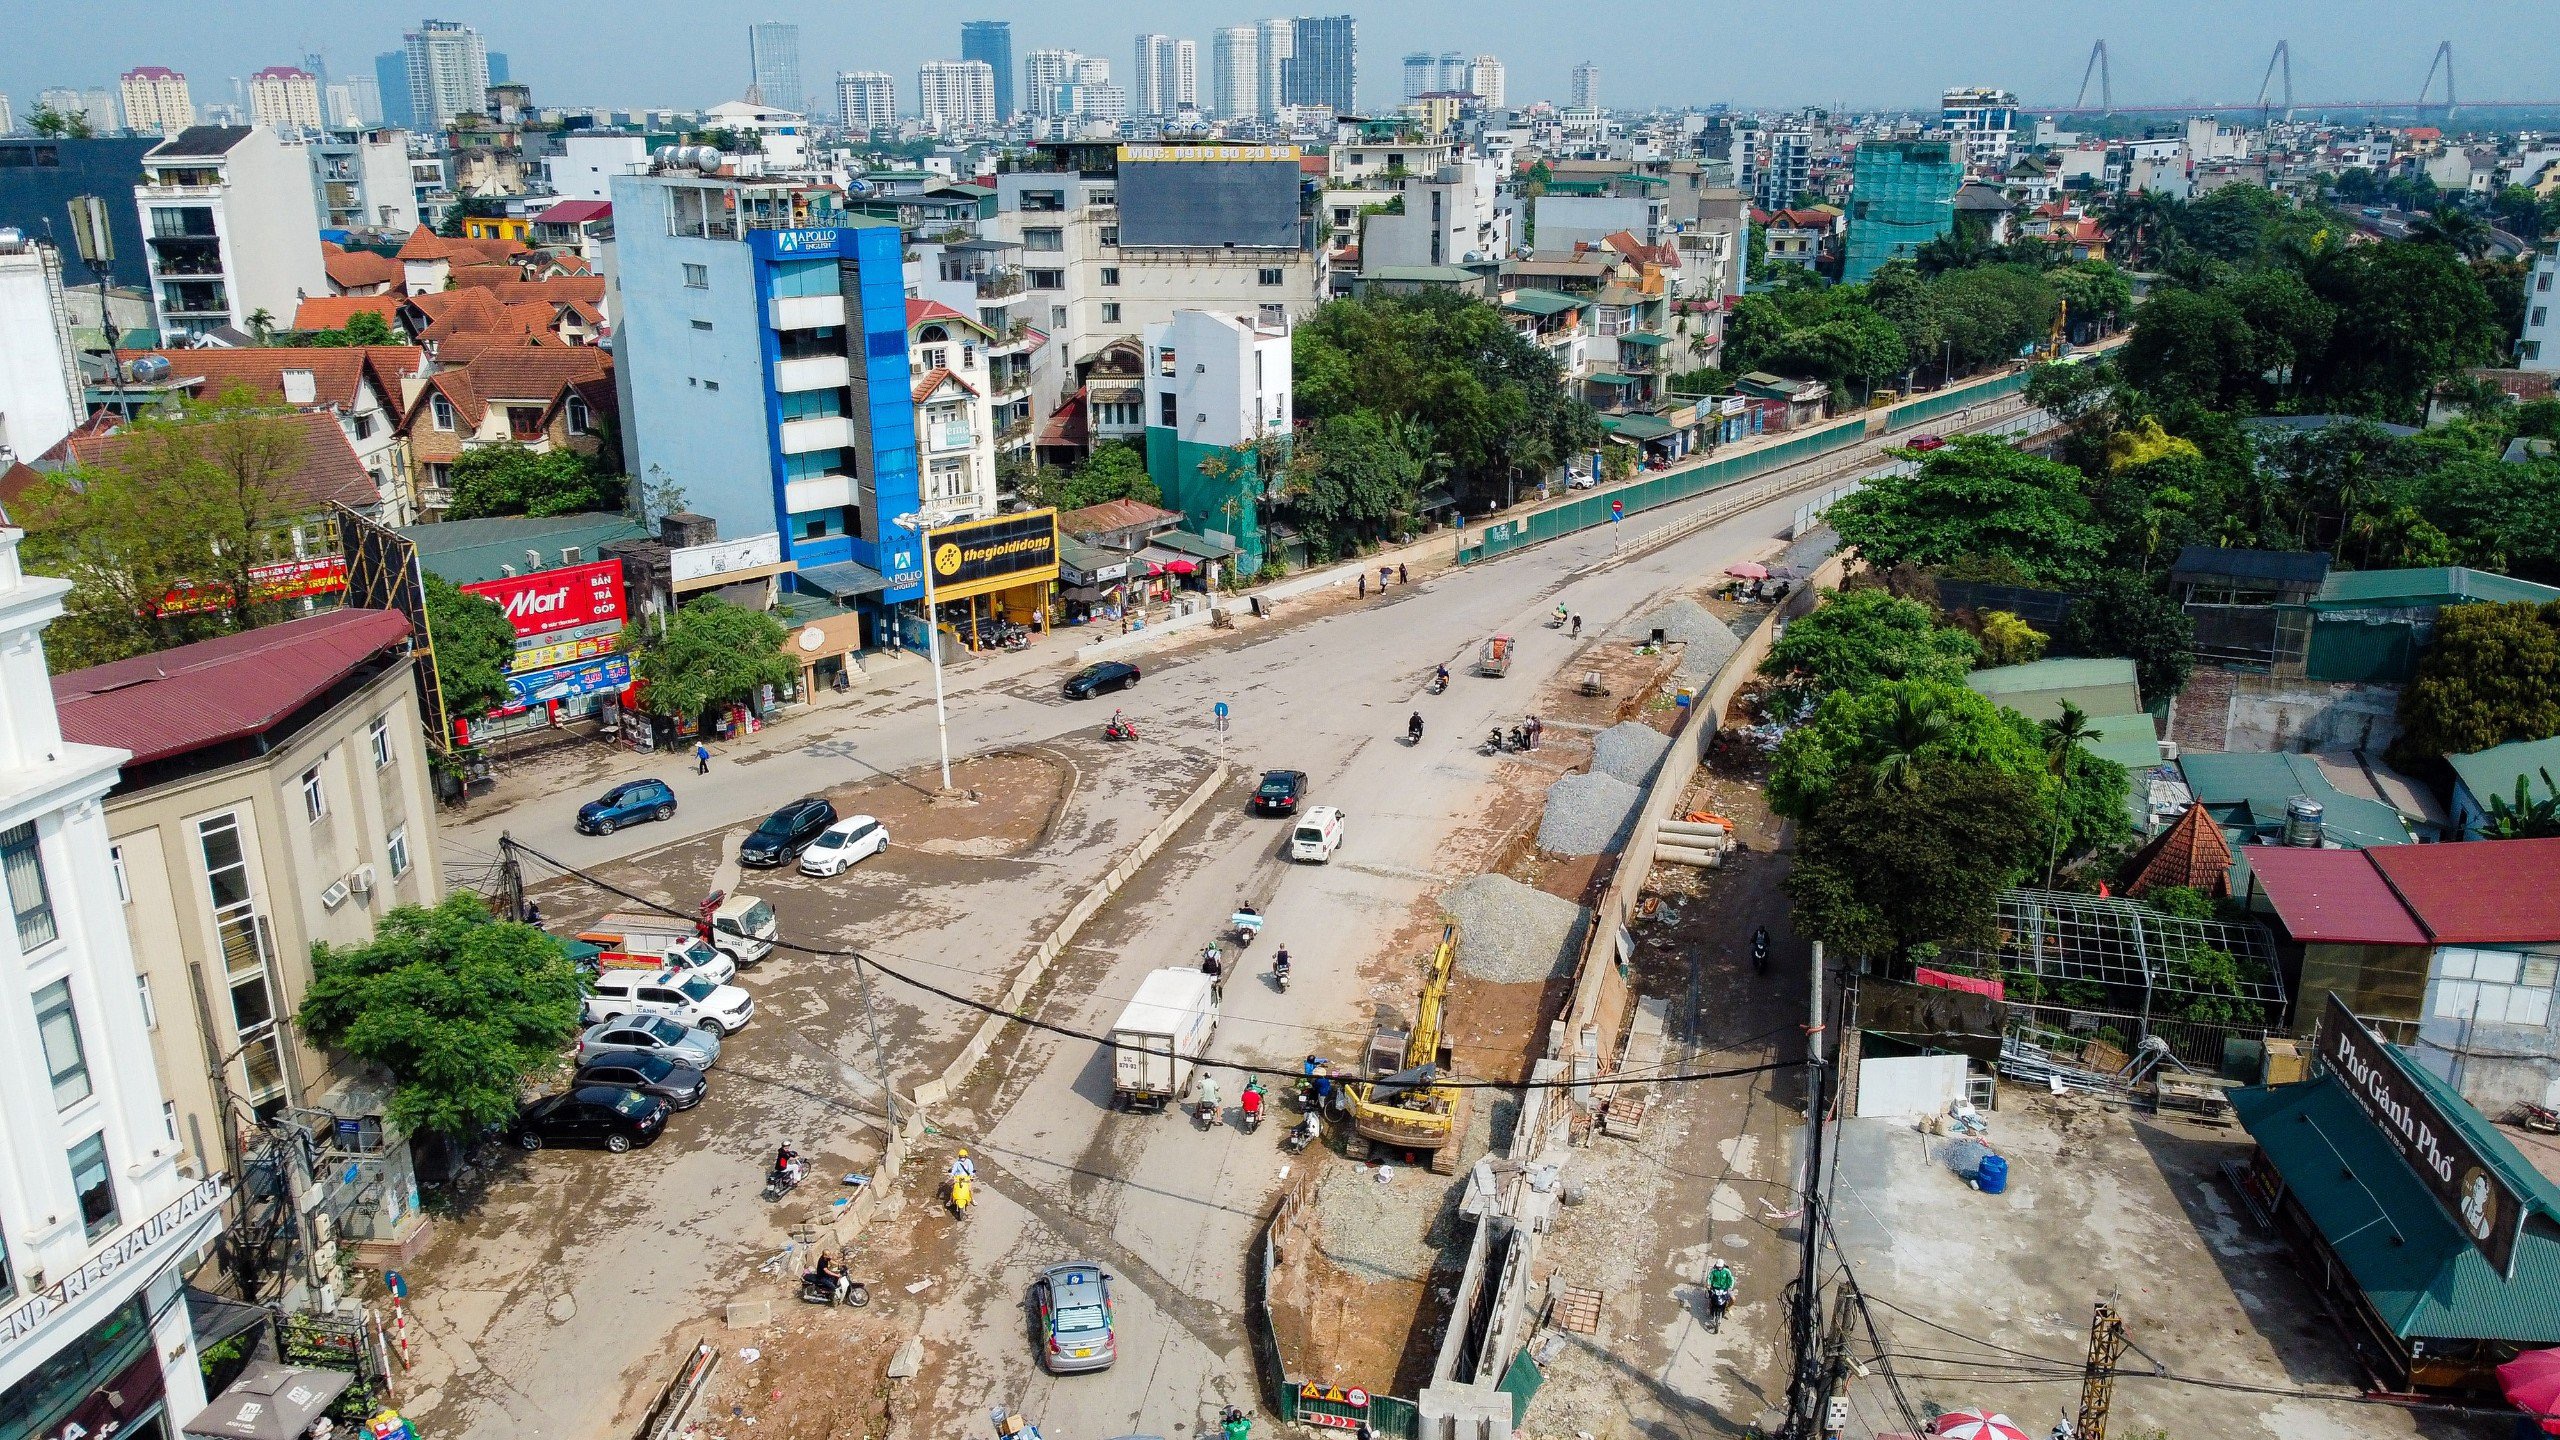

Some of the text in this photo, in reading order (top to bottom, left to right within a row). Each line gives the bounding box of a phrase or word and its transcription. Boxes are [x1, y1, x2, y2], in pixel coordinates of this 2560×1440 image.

[798, 230, 836, 242] APOLLO
[805, 242, 831, 250] ENGLISH
[963, 536, 1051, 562] thegioididong
[2336, 1032, 2456, 1183] Phở Gánh Phố
[62, 1171, 223, 1302] RESTAURANT
